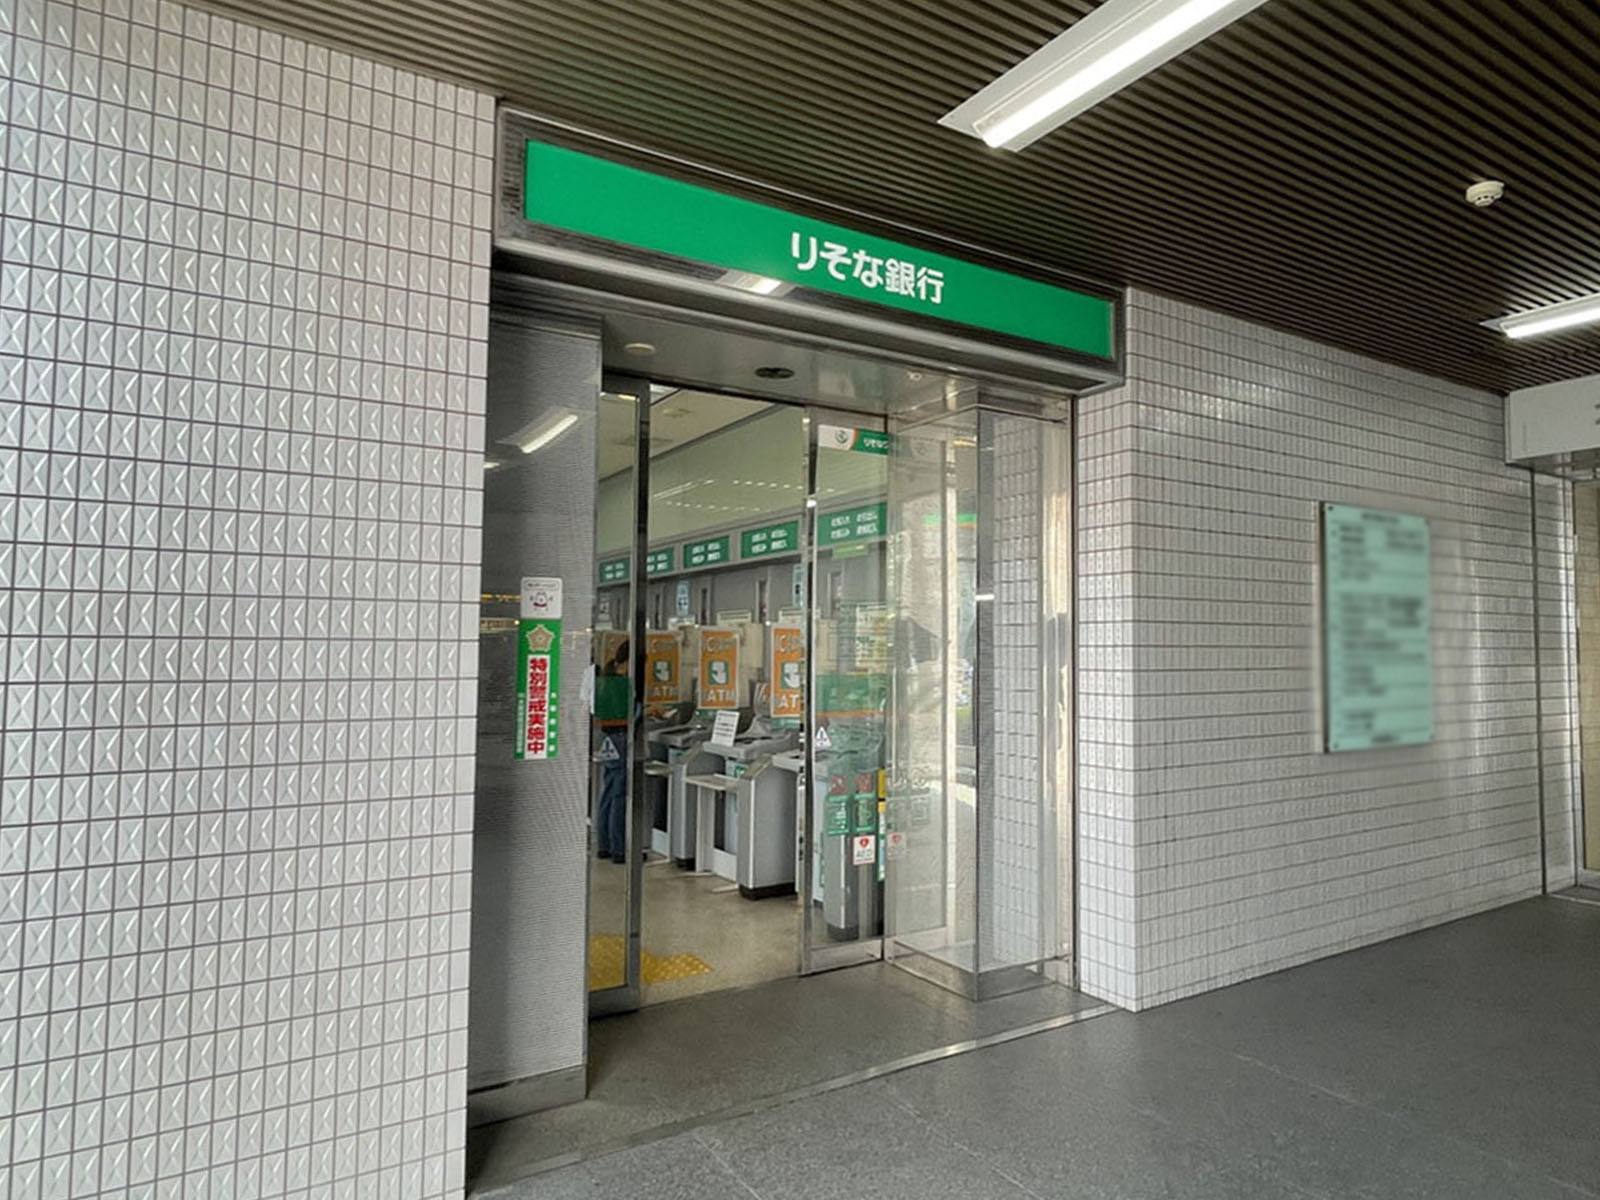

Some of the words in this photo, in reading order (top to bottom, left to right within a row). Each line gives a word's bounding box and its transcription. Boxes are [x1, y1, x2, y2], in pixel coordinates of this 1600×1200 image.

[791, 232, 945, 304] りそな銀行
[528, 658, 547, 754] 特別警戒実施中
[779, 694, 800, 708] AT
